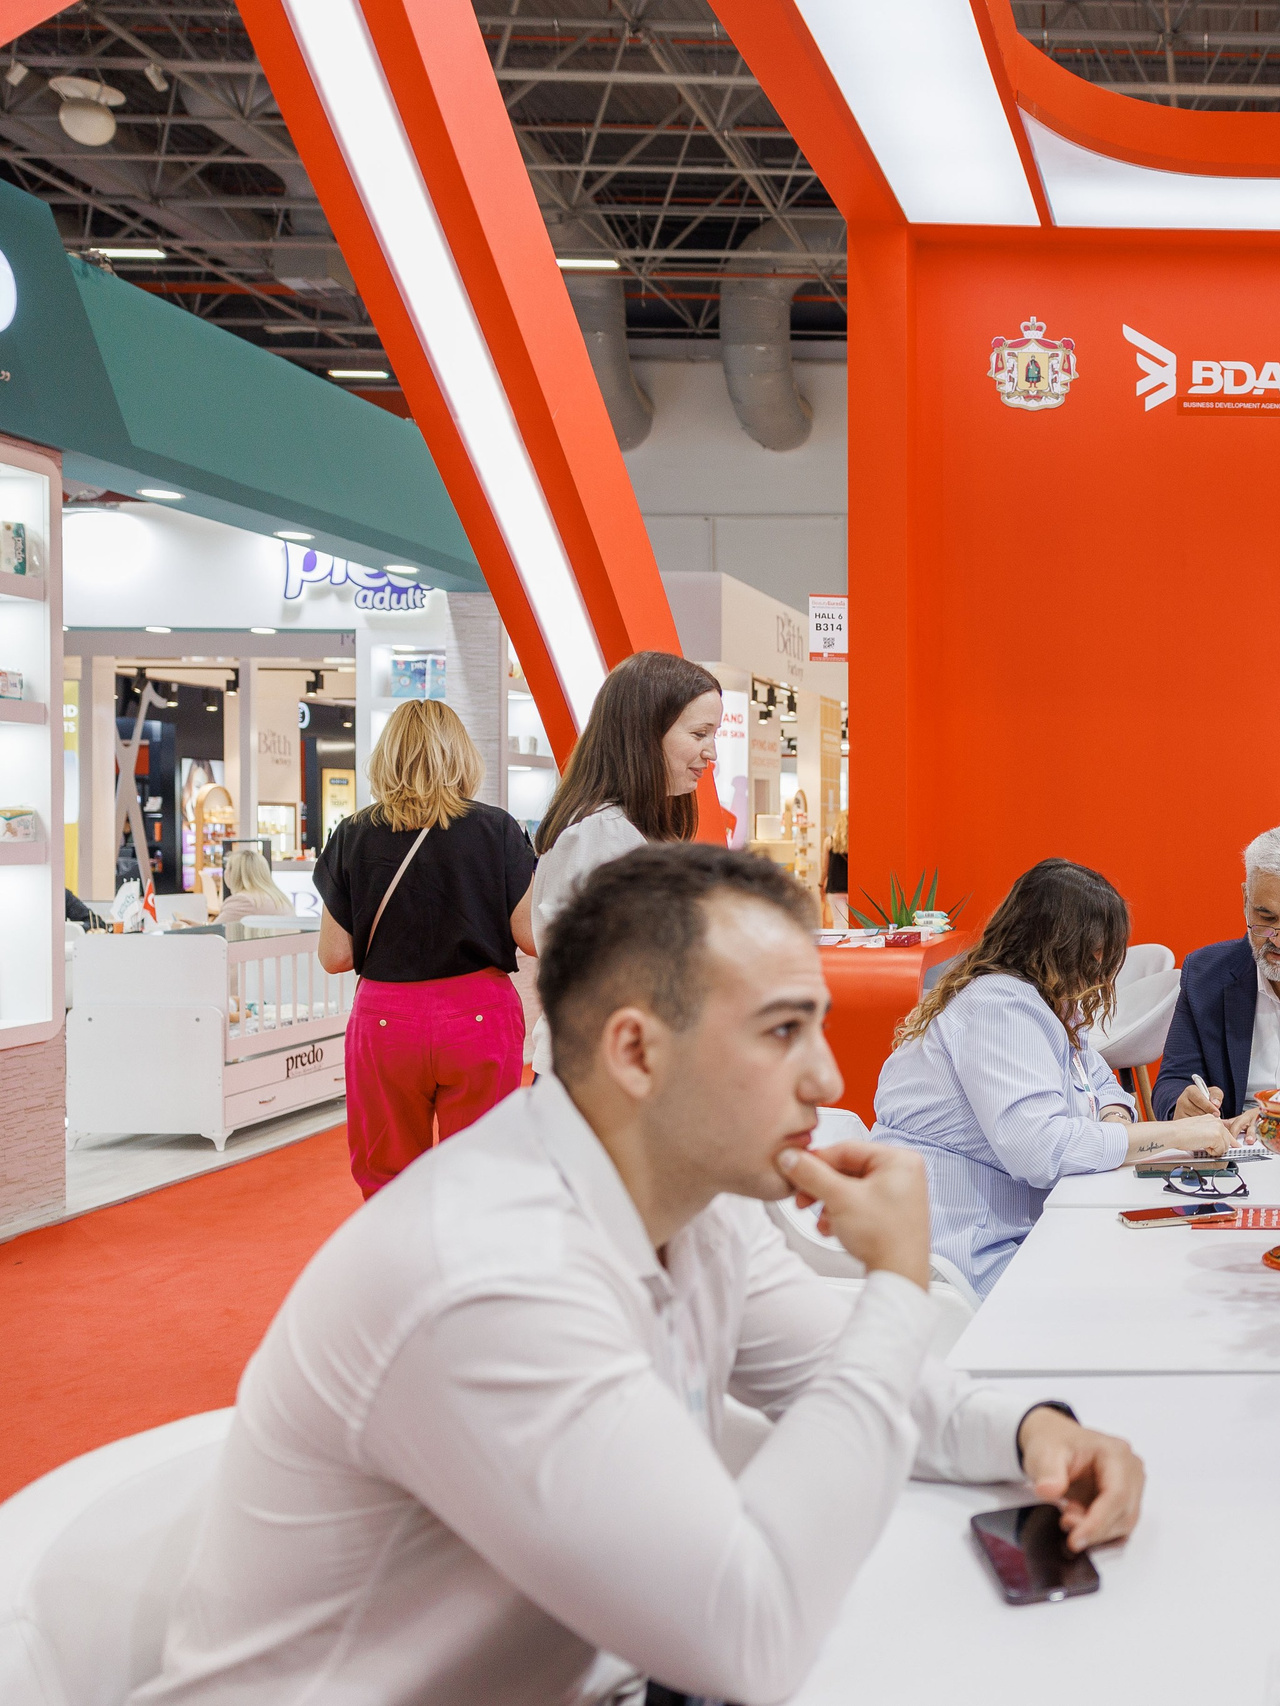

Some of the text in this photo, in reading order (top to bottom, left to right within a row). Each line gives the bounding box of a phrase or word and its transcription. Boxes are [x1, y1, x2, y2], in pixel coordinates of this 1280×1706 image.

[355, 587, 427, 611] adult
[776, 614, 804, 662] Bath
[815, 622, 842, 632] B314
[258, 731, 292, 756] Bath
[286, 1044, 324, 1078] predo
